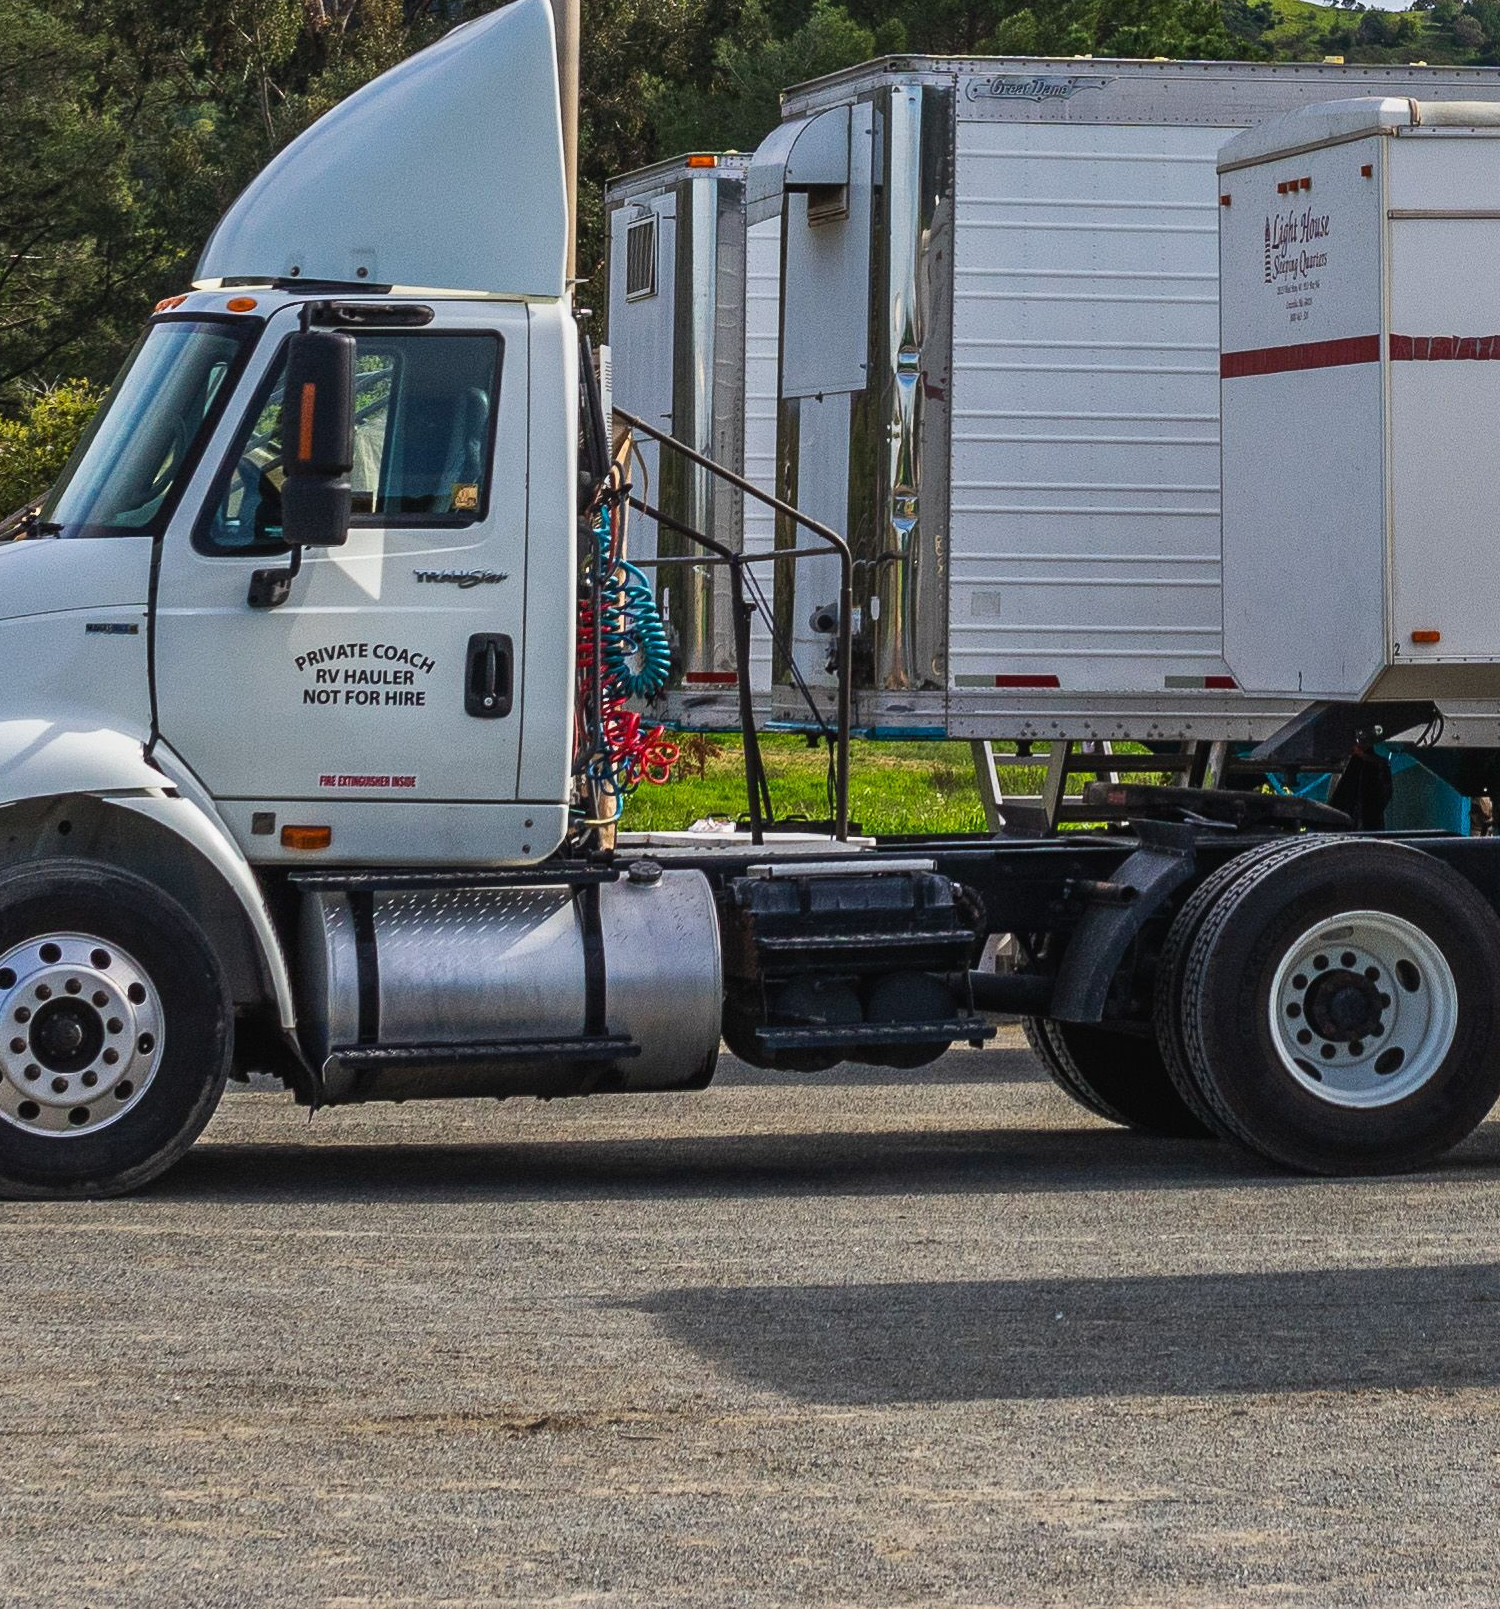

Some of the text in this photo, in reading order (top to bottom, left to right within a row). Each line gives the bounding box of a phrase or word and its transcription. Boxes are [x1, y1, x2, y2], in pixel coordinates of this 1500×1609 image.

[990, 77, 1070, 96] Great Dane
[1271, 206, 1330, 259] Light House
[1299, 249, 1328, 278] Quarters
[294, 642, 436, 674] PRIVATE COACH
[1393, 642, 1401, 657] 2
[315, 668, 415, 686] RV HAULER
[303, 689, 426, 707] NOT FOR HIRE
[319, 775, 417, 788] FIRE EXTINGUISHER INSIDE
